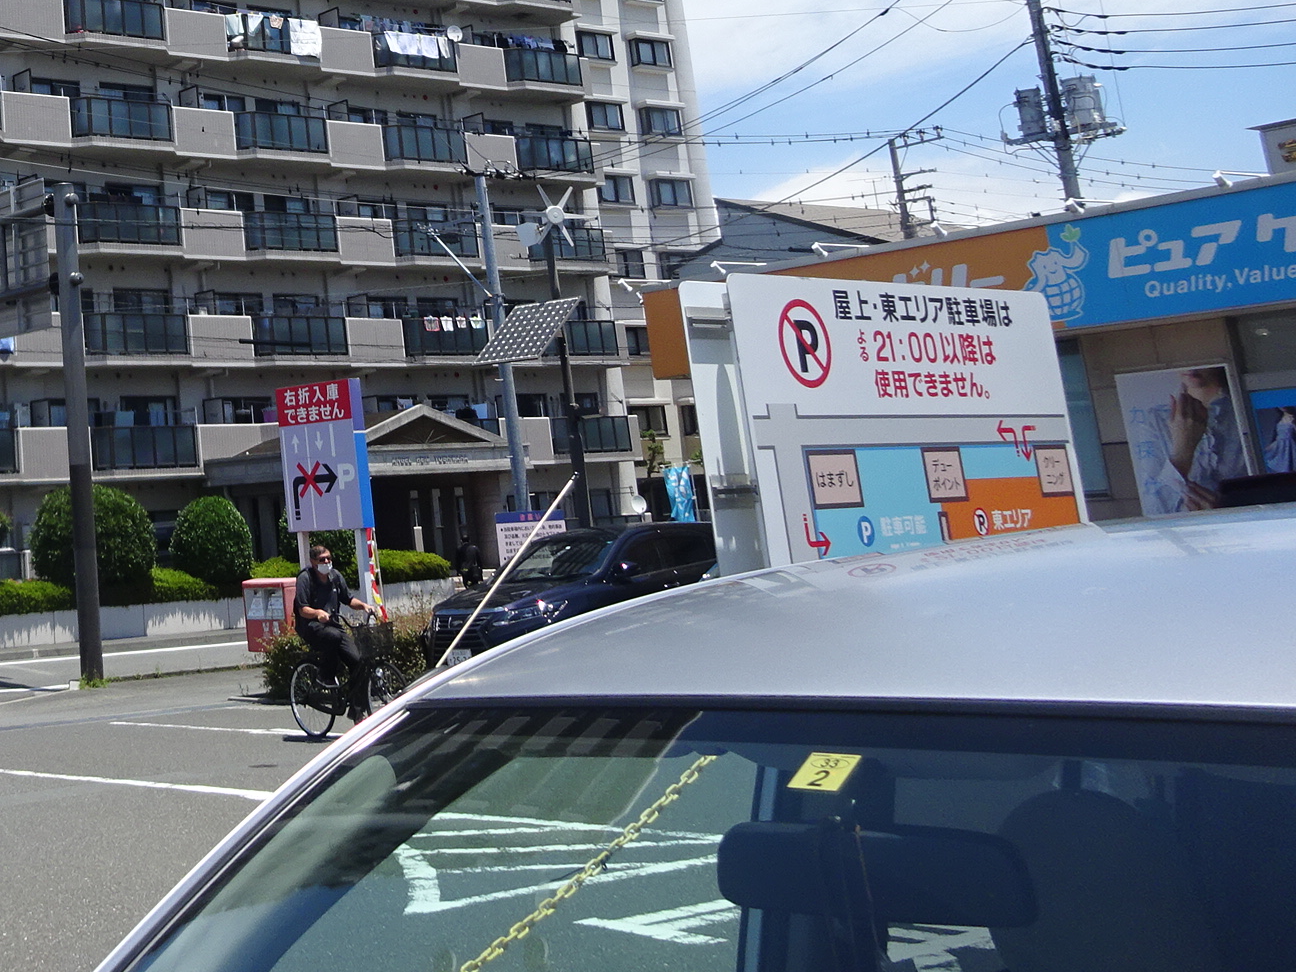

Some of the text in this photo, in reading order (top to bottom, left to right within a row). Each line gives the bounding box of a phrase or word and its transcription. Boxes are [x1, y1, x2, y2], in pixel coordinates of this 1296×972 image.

[832, 289, 1013, 328] 屋上・東エリア駐車場は
[284, 383, 340, 407] 右折入庫
[874, 369, 991, 400] 使用できません。
[284, 402, 345, 424] できません
[337, 462, 355, 490] P
[991, 509, 1032, 530] 東エリア
[806, 769, 831, 787] 2
